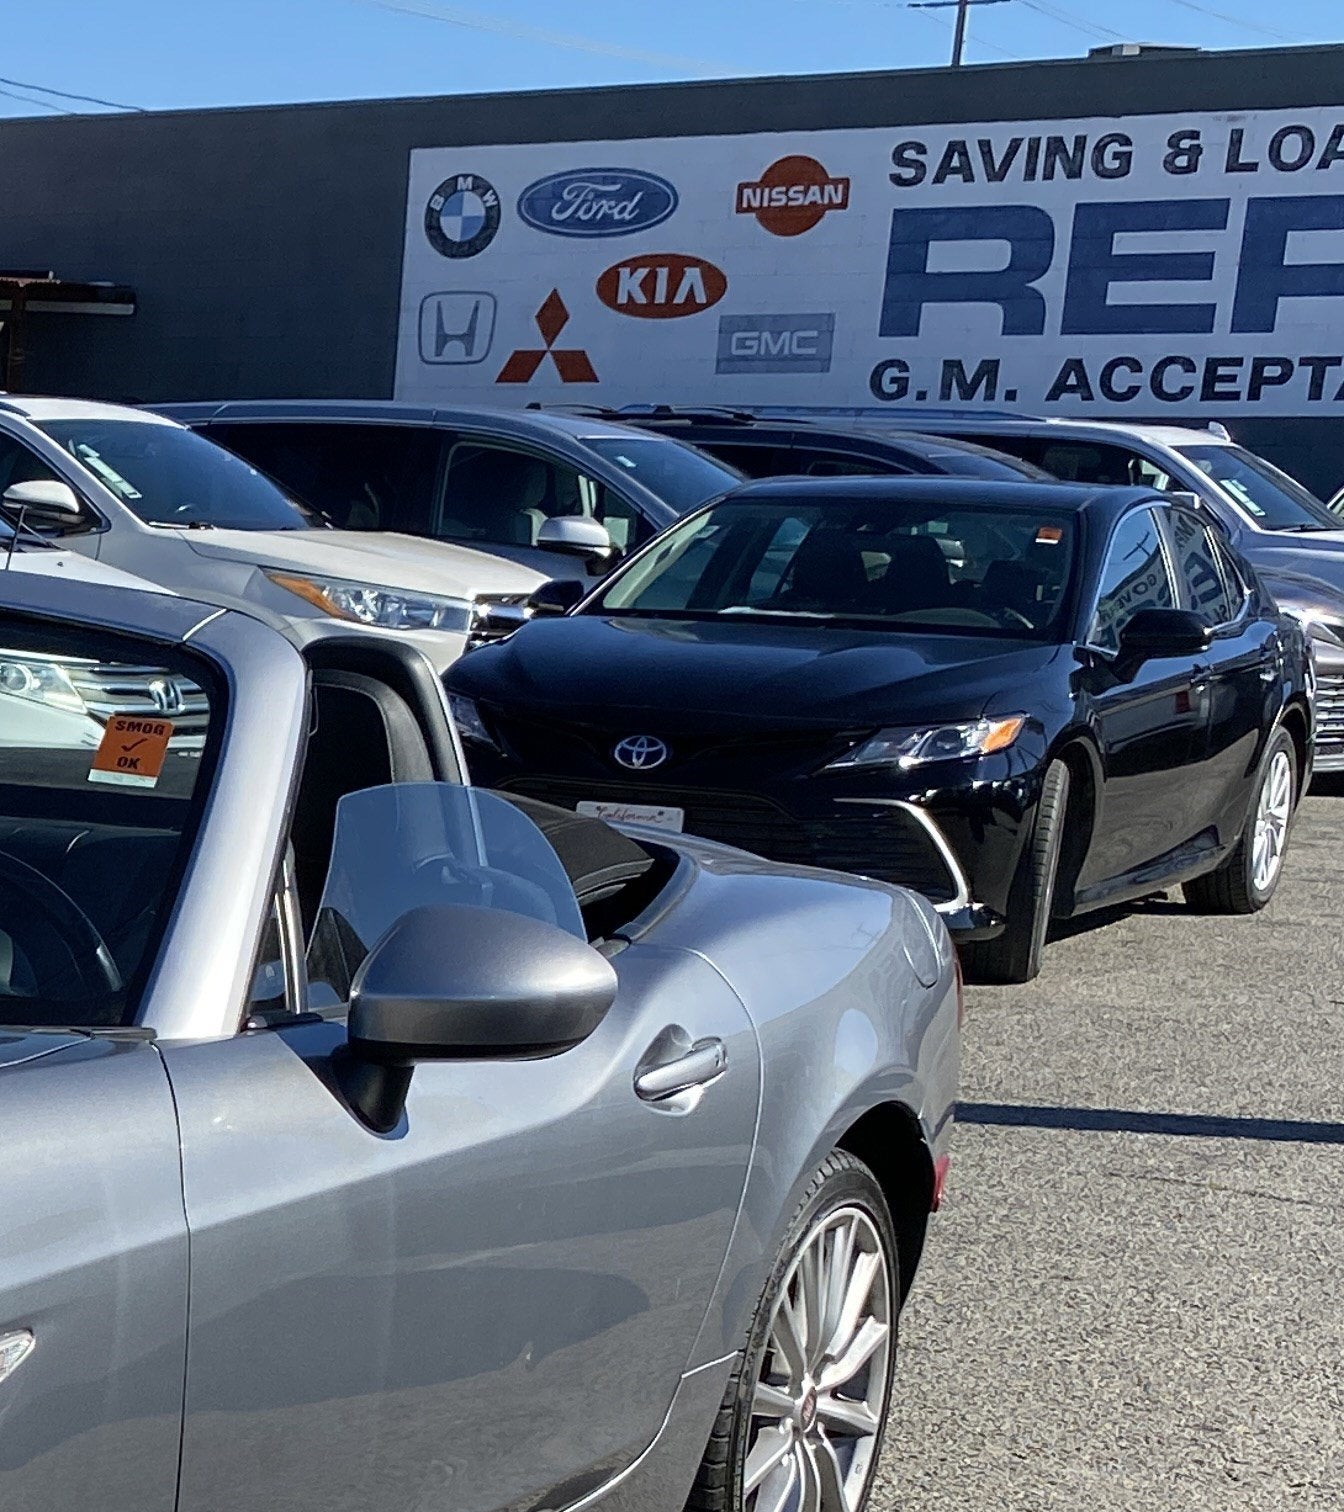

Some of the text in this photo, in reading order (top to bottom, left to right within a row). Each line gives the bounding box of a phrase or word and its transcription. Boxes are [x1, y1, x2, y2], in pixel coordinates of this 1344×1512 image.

[888, 131, 1134, 188] SAVING
[1162, 129, 1204, 175] &
[429, 175, 498, 212] BMW
[551, 181, 643, 221] Ford
[741, 184, 844, 208] NISSAN
[616, 266, 708, 304] KIA
[731, 330, 819, 356] GMC
[869, 357, 1018, 402] G.M.
[115, 720, 165, 736] SMOG
[116, 756, 141, 770] OK
